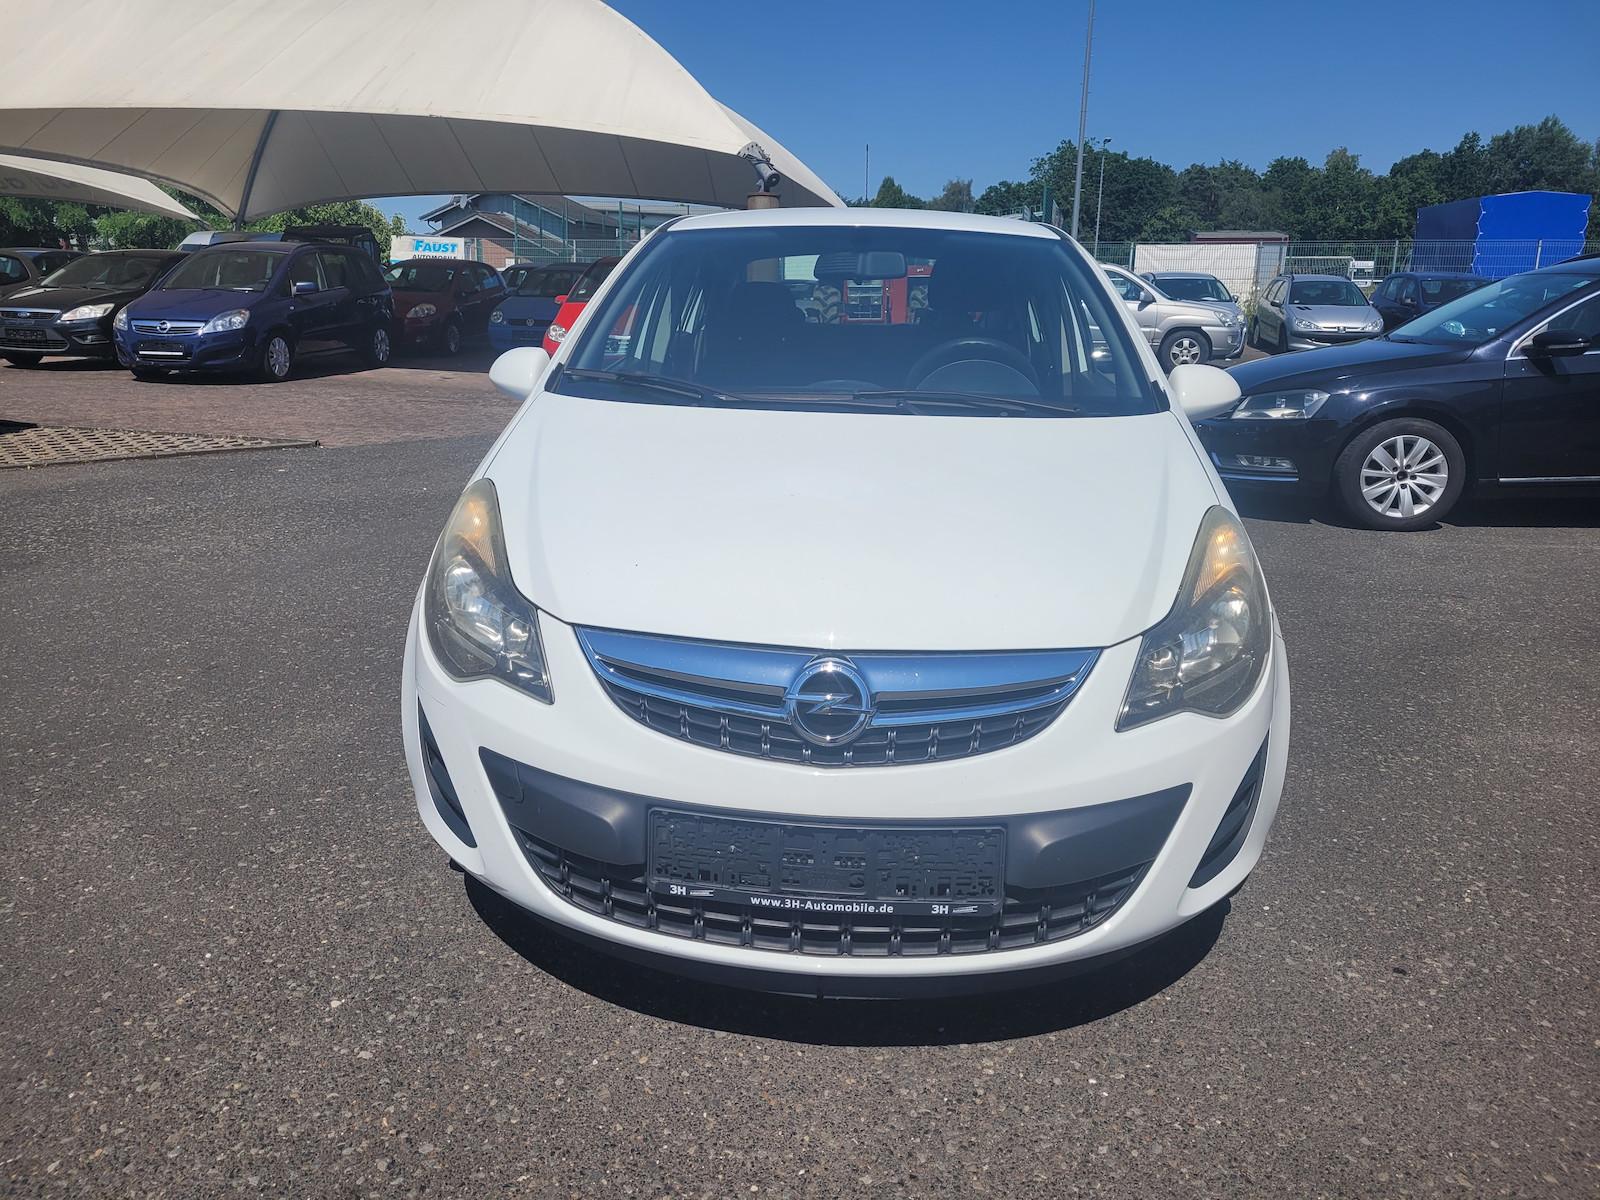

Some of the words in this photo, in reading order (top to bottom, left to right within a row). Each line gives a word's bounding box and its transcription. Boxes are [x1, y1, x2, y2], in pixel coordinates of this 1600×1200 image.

[414, 239, 457, 253] FAUST
[669, 884, 687, 896] 3H
[750, 896, 894, 914] www.3H-Automobile.de
[931, 904, 949, 915] 3H
